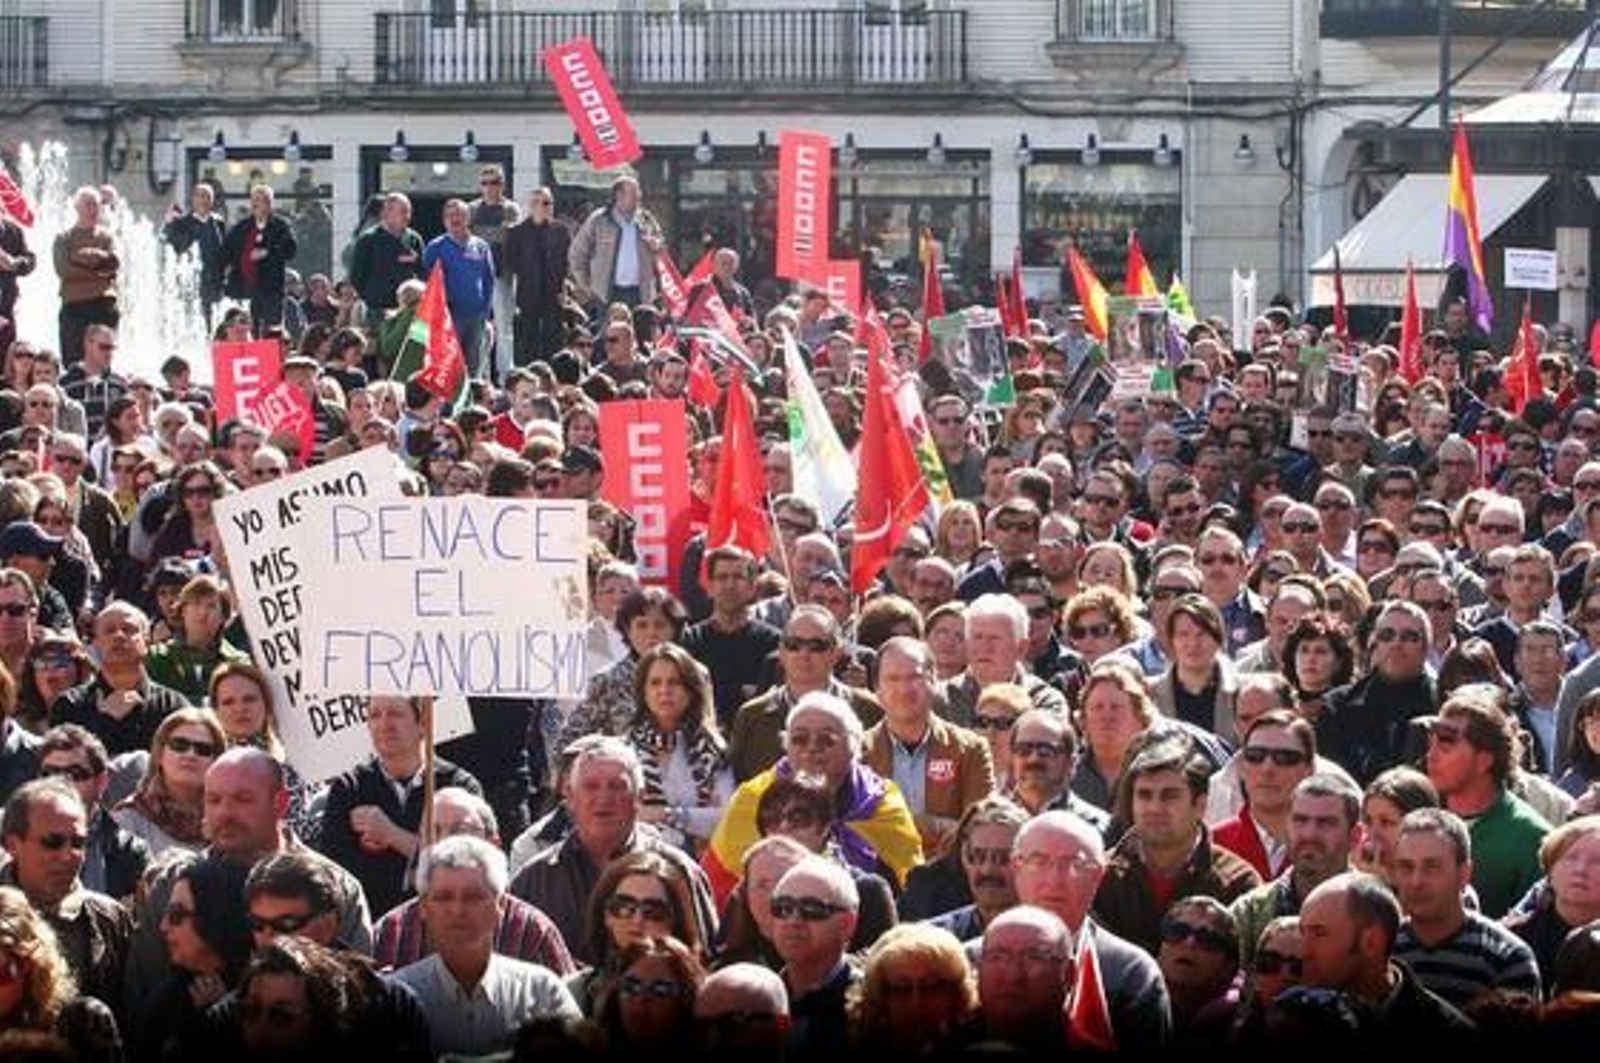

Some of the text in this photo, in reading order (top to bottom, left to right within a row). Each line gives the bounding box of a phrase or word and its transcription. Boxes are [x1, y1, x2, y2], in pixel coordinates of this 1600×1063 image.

[562, 53, 612, 127] CCOO
[794, 146, 817, 232] CCOO
[232, 470, 368, 545] YO ASMO
[332, 503, 578, 563] RENACE
[627, 422, 669, 577] CCOO
[250, 547, 299, 590] MIS
[415, 568, 495, 617] EL
